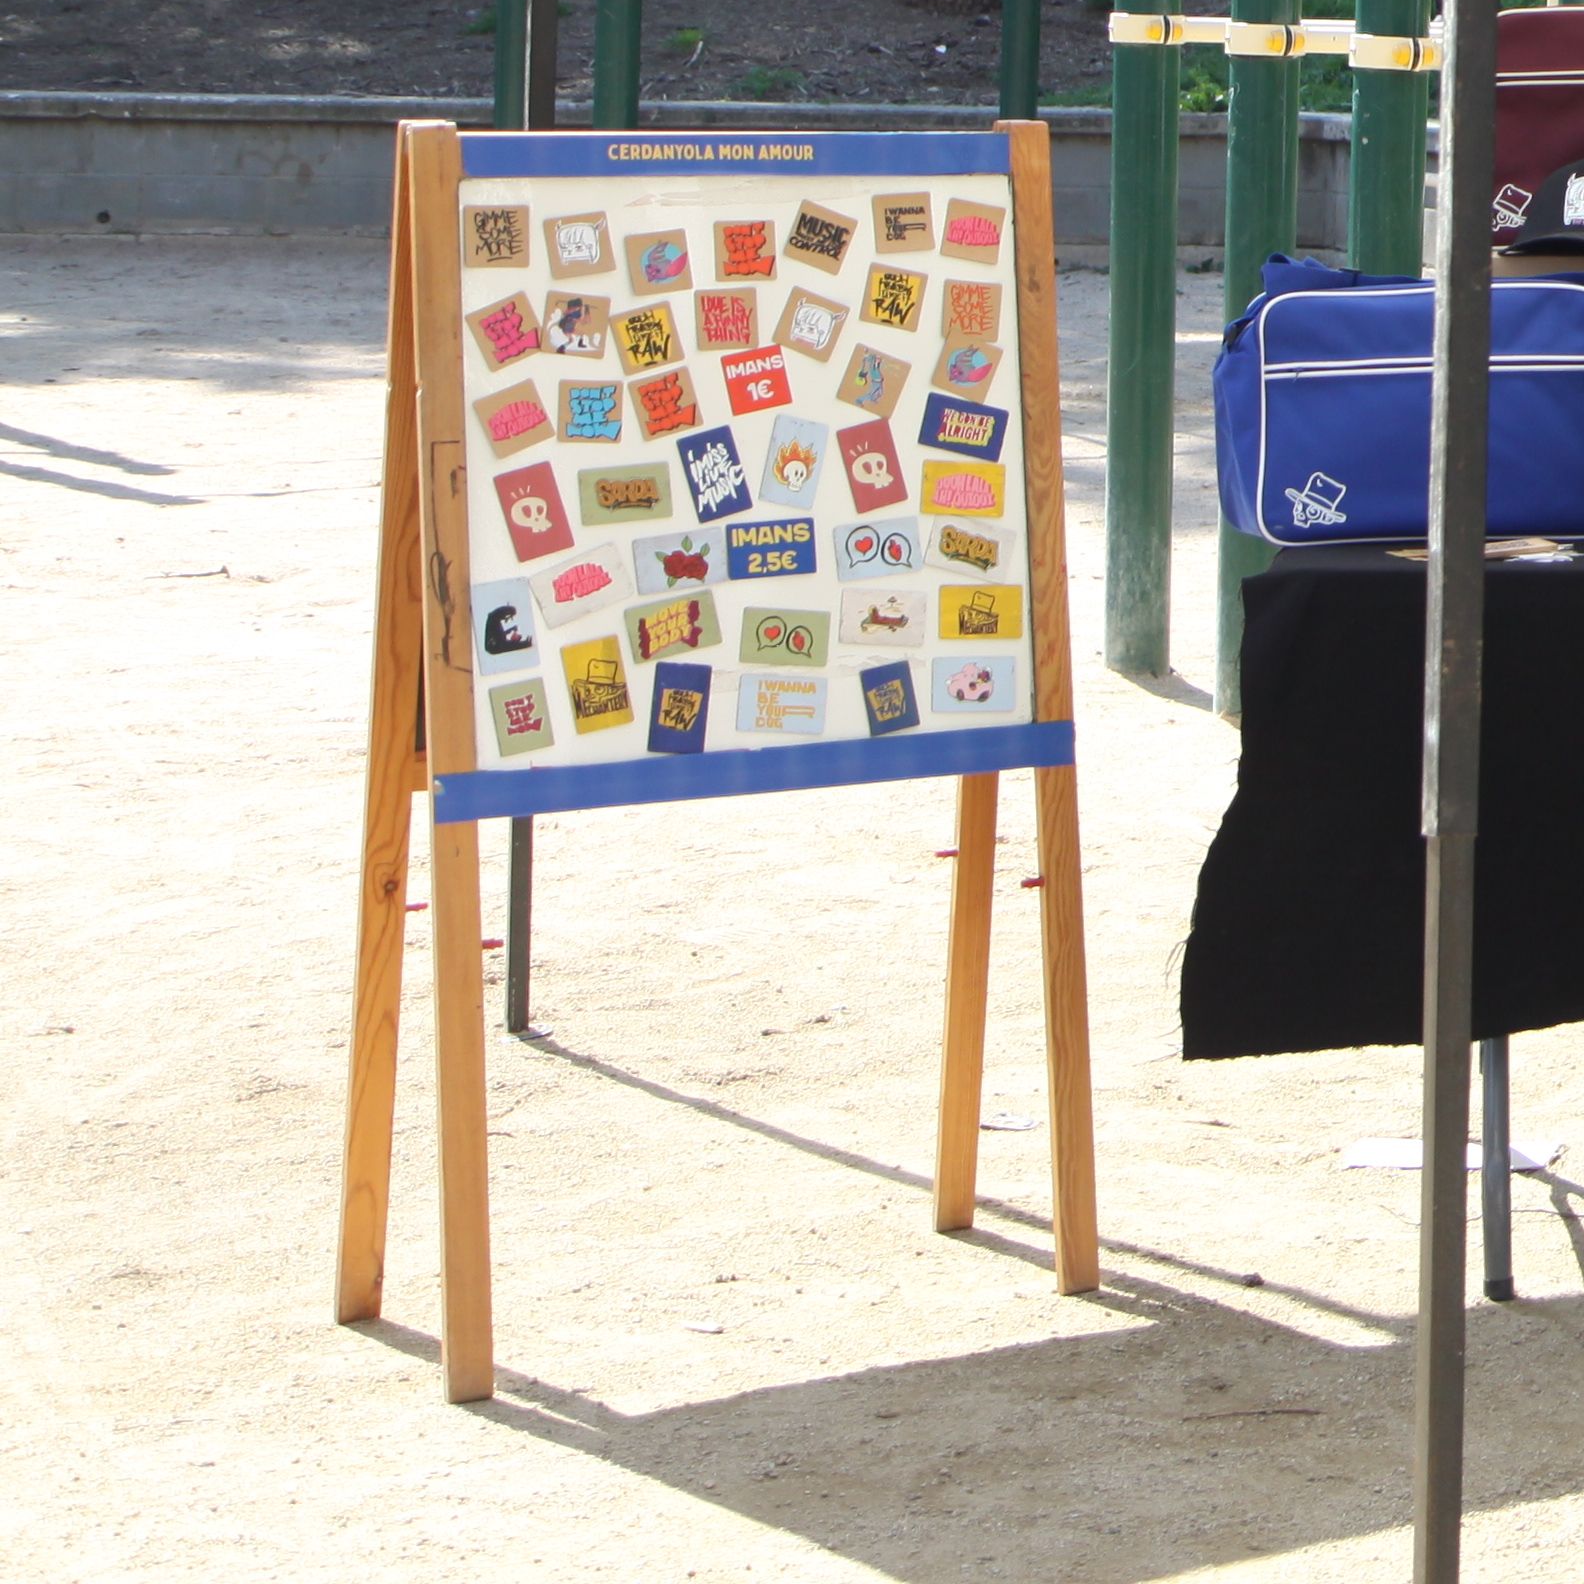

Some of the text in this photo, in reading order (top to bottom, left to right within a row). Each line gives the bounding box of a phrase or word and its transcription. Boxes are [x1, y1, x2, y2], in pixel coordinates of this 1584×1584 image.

[608, 143, 814, 161] CERDANYOLA MON AMOUR
[474, 209, 518, 228] GIMME
[889, 206, 925, 216] WANNA
[476, 224, 522, 240] SOME
[796, 213, 849, 244] MUSIC
[475, 238, 523, 257] MORE
[872, 297, 916, 326] RAW
[725, 354, 784, 380] IMANS
[747, 379, 775, 401] 1€
[731, 523, 811, 547] IMANS
[748, 550, 798, 573] 2,5€
[765, 680, 817, 694] WANNA
[757, 692, 780, 704] BE
